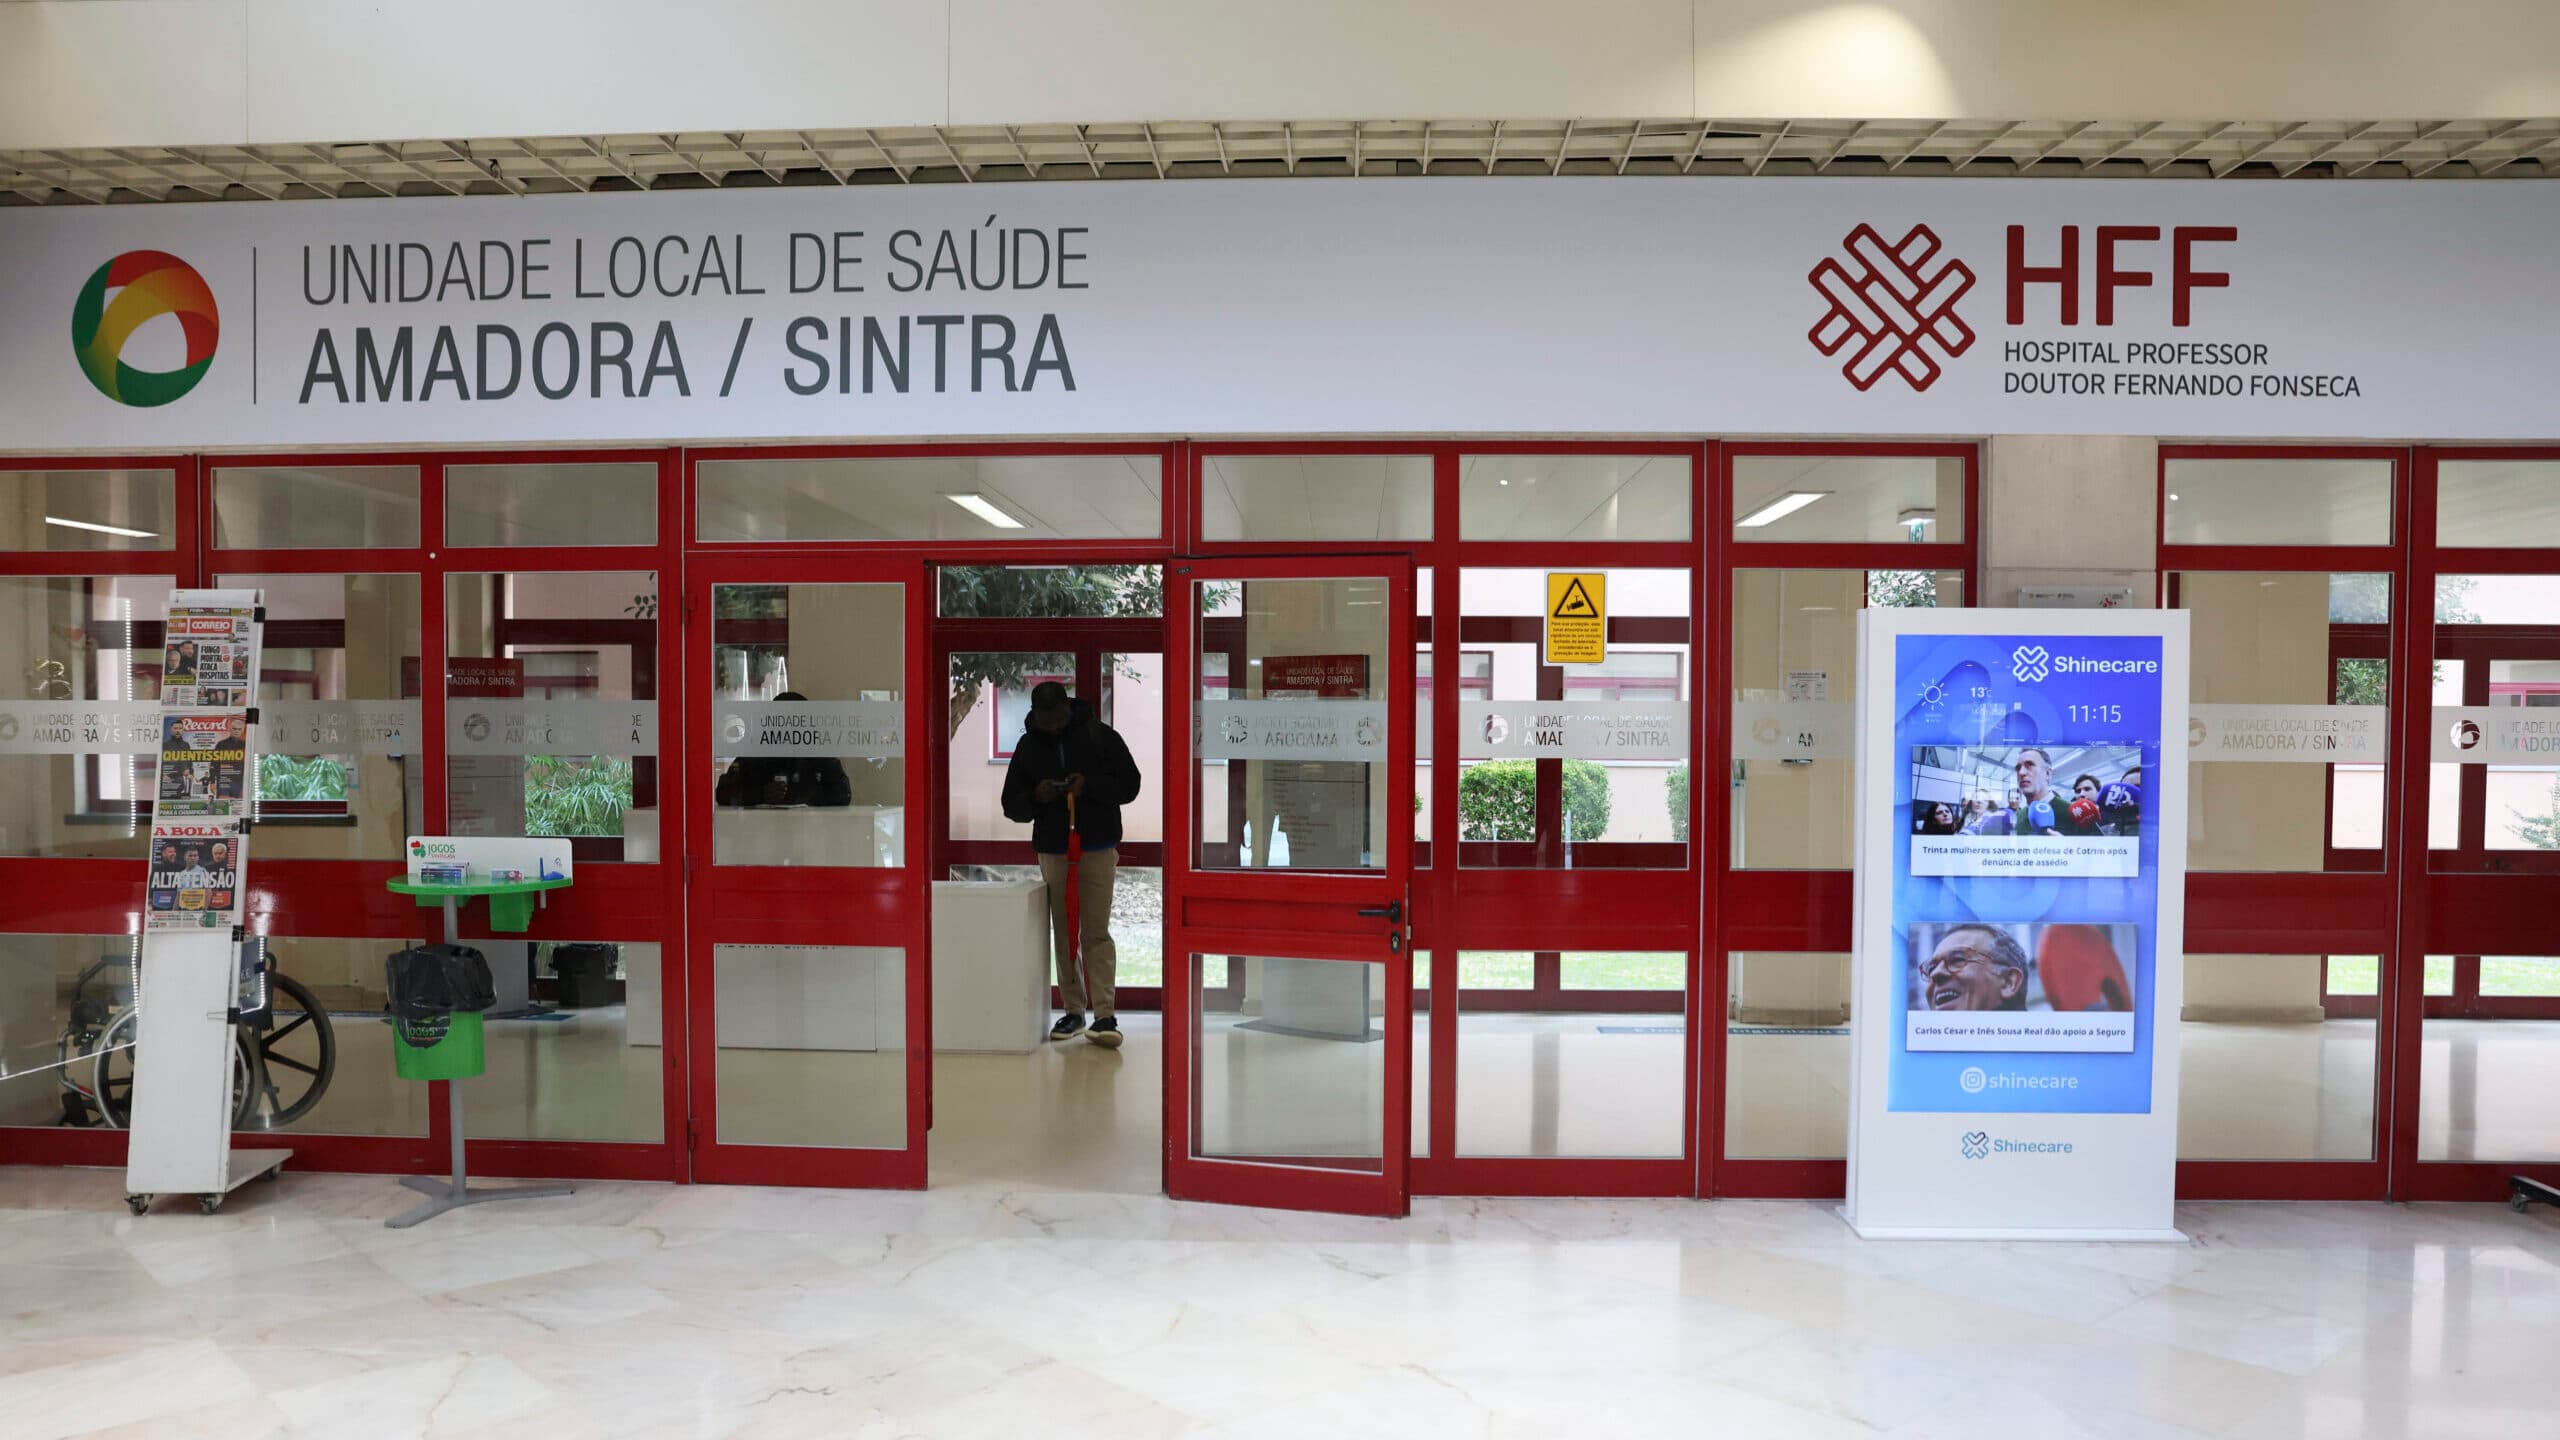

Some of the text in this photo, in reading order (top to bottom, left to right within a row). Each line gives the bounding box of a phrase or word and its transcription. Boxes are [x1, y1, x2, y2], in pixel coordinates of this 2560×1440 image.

[303, 214, 1089, 306] UNIDADE LOCAL DE SAÚDE
[2006, 224, 2238, 327] HFF
[298, 313, 1077, 404] AMADORA / SINTRA
[2005, 341, 2268, 365] HOSPITAL PROFESSOR
[2004, 372, 2361, 397] DOUTOR FERNANDO FONSECA
[2054, 655, 2158, 674] Shinecare
[1327, 676, 1354, 685] SINTRA
[760, 714, 807, 728] UNIDADE
[2068, 704, 2122, 723] 11:15
[183, 718, 226, 730] Record
[760, 729, 832, 745] AMADORA
[1604, 730, 1613, 746] /
[1616, 730, 1671, 746] SINTRA
[2221, 734, 2296, 750] AMADORA
[163, 748, 243, 762] QUENTÍSSIMO
[154, 827, 222, 836] A BOLA
[428, 844, 456, 855] JOGOS
[1922, 846, 1948, 854] Trinta
[2032, 847, 2061, 855] defesa
[2063, 847, 2074, 855] de
[2108, 848, 2128, 857] após
[1982, 858, 2069, 867] denúncia de assédio
[151, 868, 235, 889] ALTA TENSÃO
[1915, 1026, 1942, 1035] Carlos
[1943, 1026, 1967, 1035] César
[1977, 1027, 1995, 1035] Inês
[1997, 1027, 2022, 1035] Sousa
[2024, 1027, 2043, 1036] Real
[2044, 1027, 2061, 1036] dão
[2062, 1029, 2087, 1037] apoio
[2096, 1028, 2127, 1038] Seguro
[1989, 1072, 2079, 1089] shinecare
[1993, 1139, 2073, 1154] Shinecare
